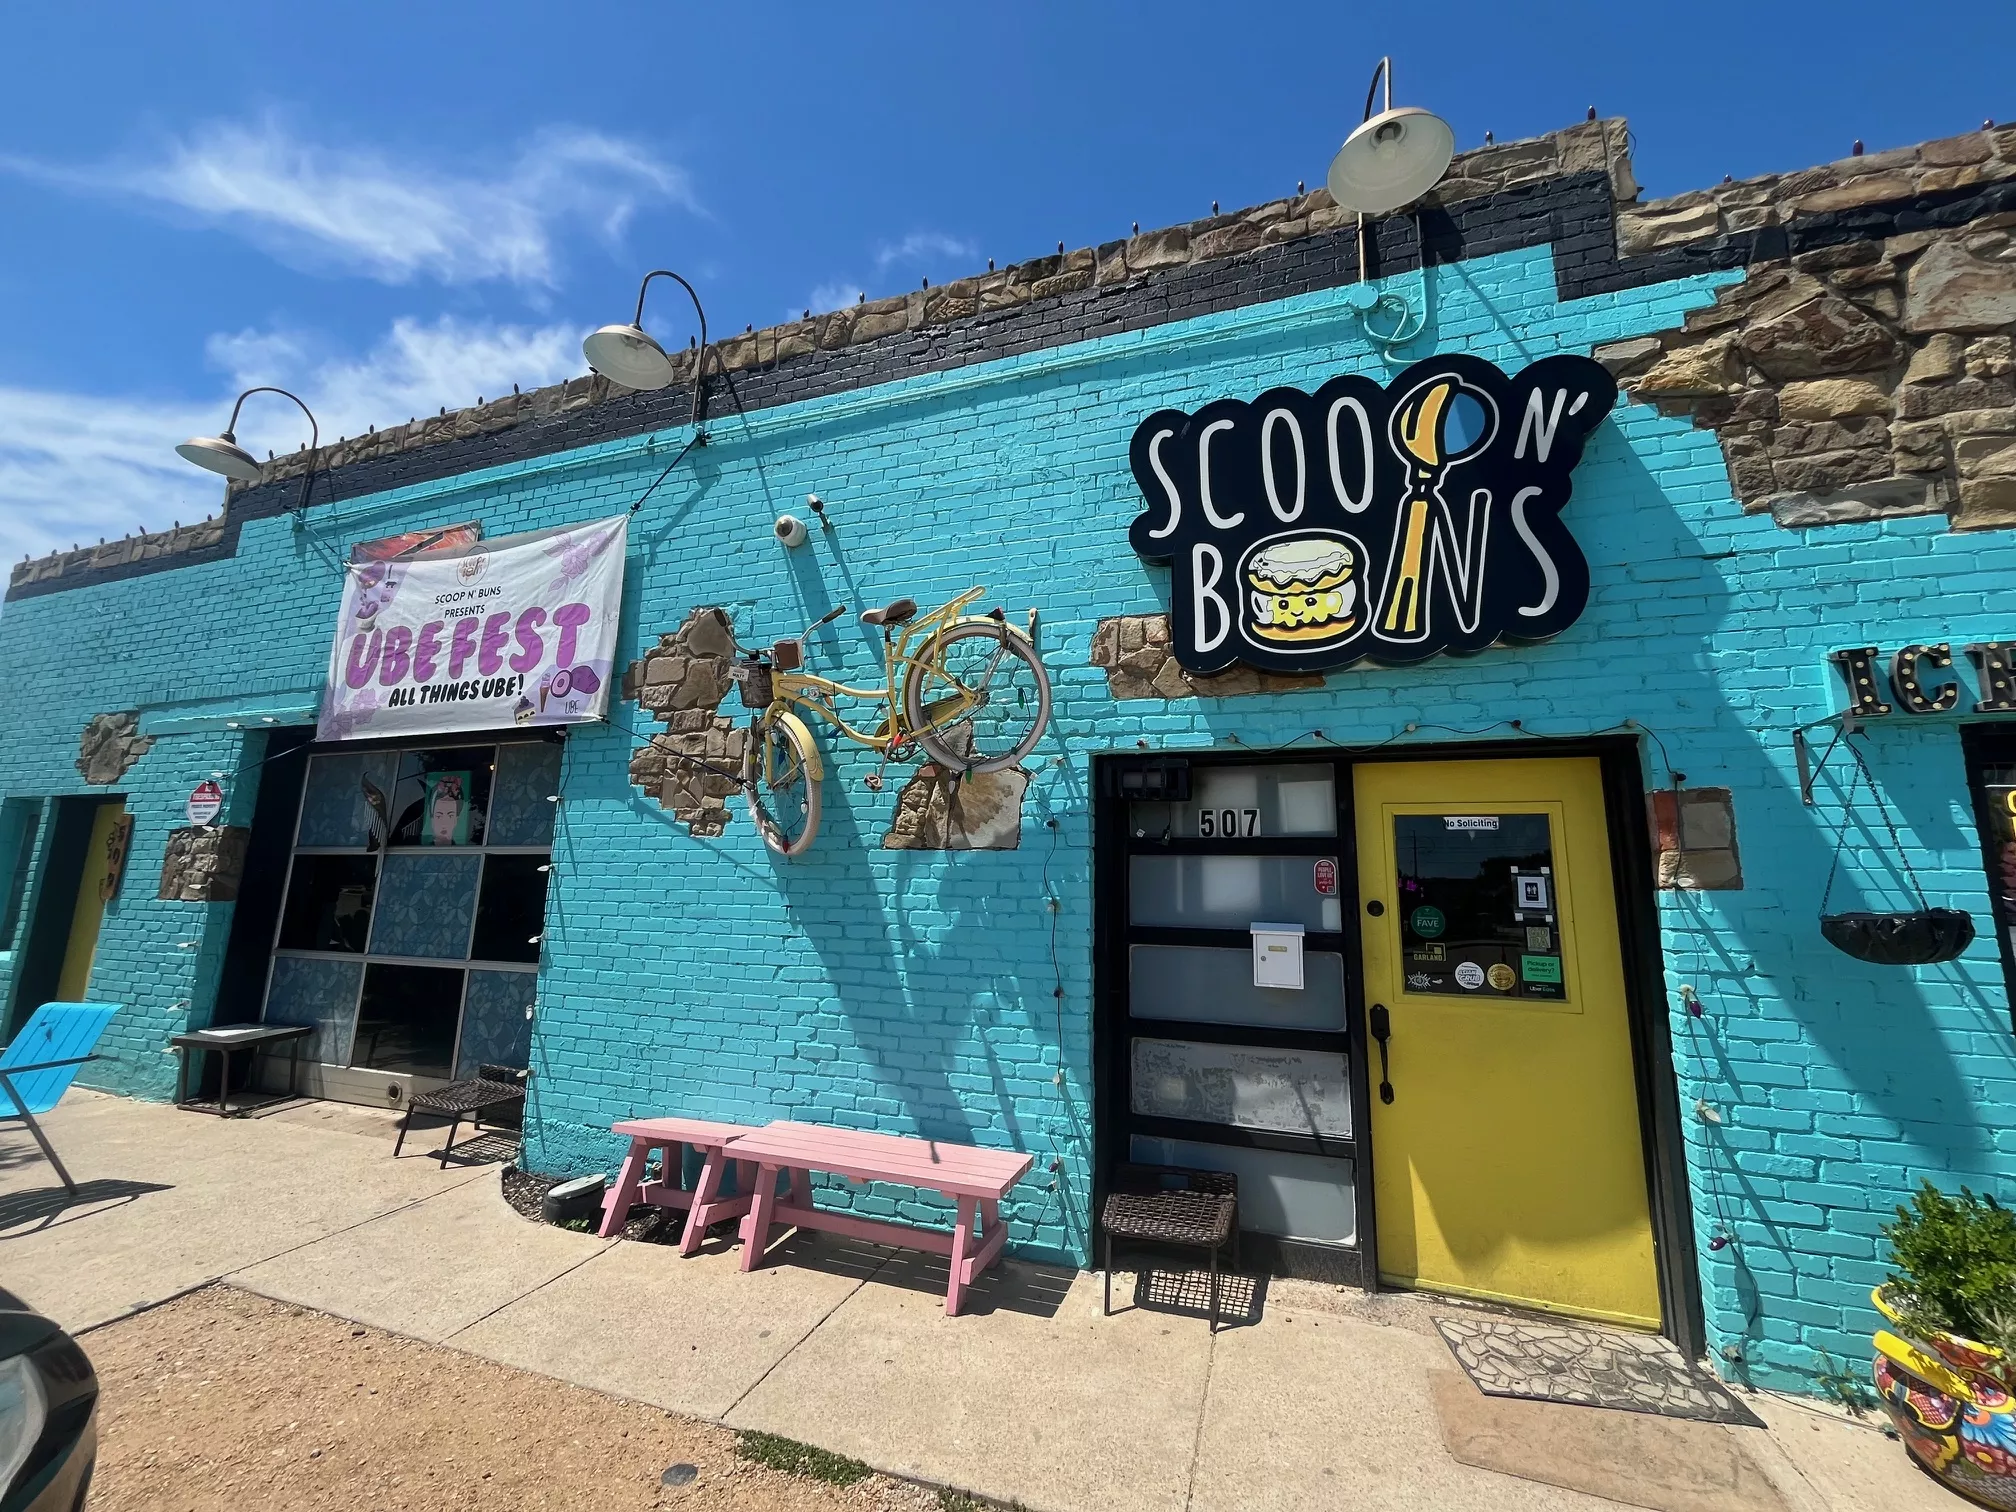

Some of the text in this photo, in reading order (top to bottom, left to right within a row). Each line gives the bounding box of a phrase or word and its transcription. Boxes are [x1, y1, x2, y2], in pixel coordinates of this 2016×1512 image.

[1514, 386, 1589, 463] N'
[435, 585, 502, 605] SCOOP N' BUNS
[444, 604, 486, 619] PRESENTS
[389, 673, 525, 708] ALL THINGS UBE!
[564, 699, 580, 715] UBE
[1201, 809, 1258, 838] 507
[1444, 819, 1498, 829] No Soliciting
[1416, 919, 1440, 928] FAVE
[1413, 953, 1443, 961] GARLAND
